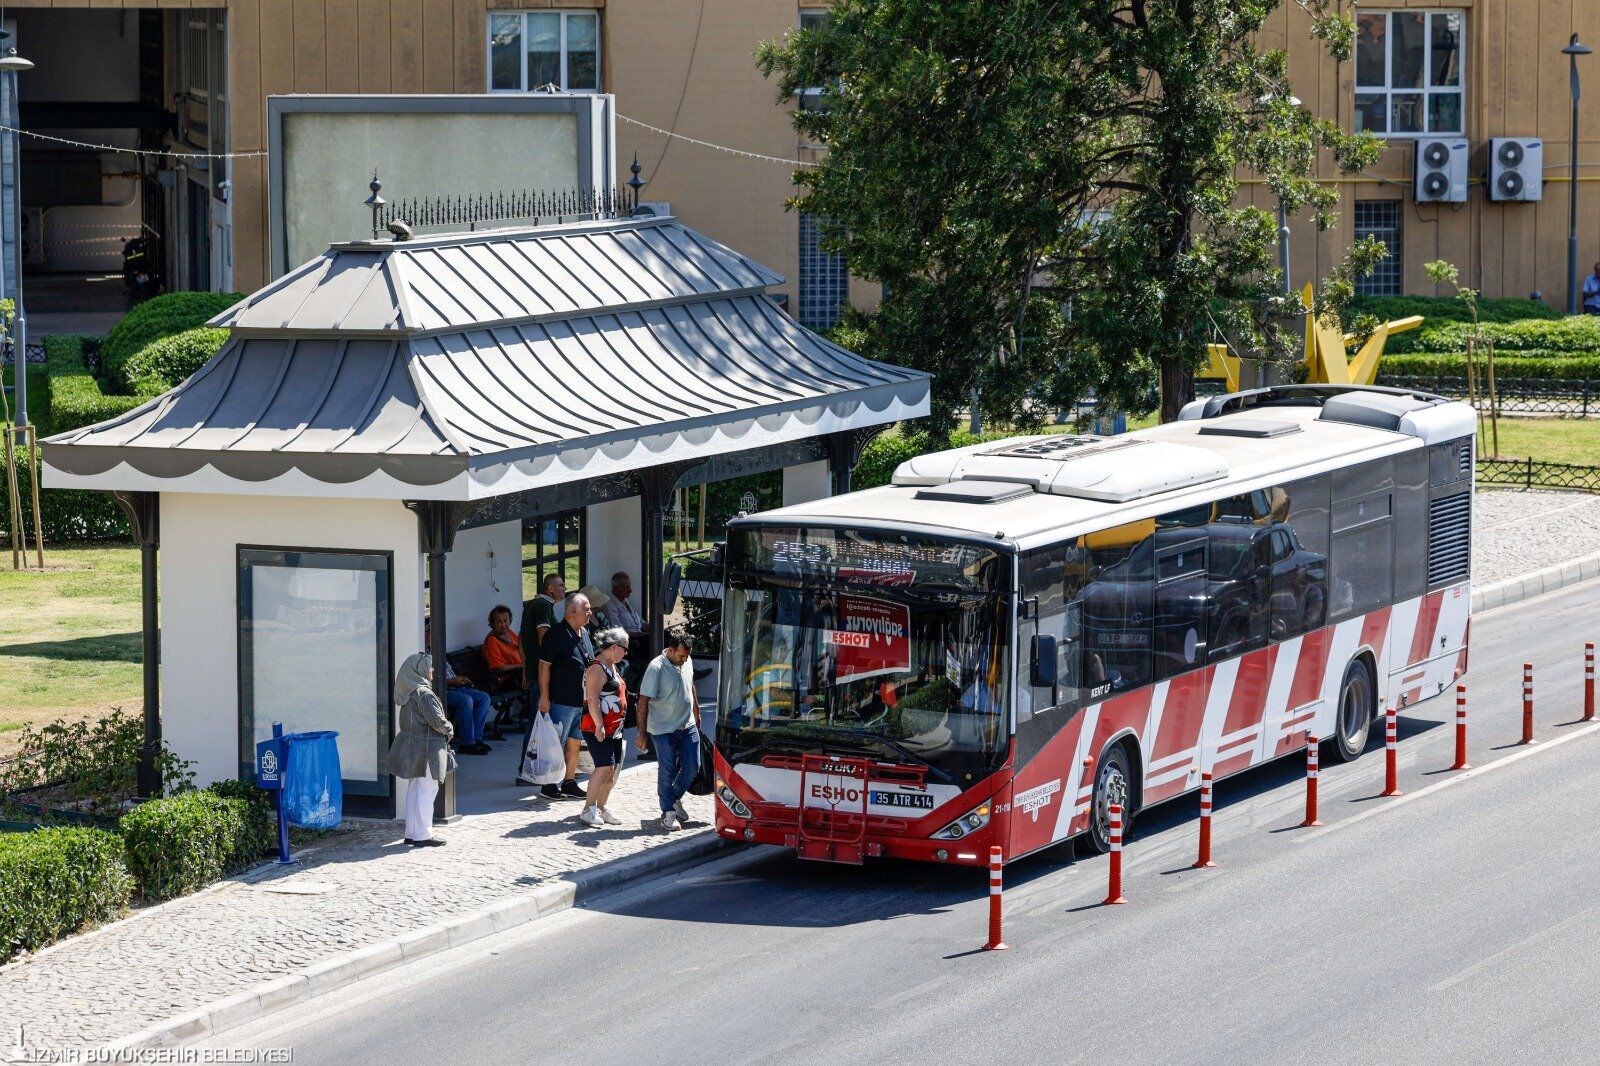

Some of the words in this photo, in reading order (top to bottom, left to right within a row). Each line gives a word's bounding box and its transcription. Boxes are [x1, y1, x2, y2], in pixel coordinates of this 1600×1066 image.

[832, 632, 869, 646] ESHOT
[1090, 685, 1104, 698] KENT
[876, 793, 889, 804] 35
[893, 794, 911, 806] ATR
[914, 796, 932, 808] 414
[1024, 795, 1050, 812] ESHOT
